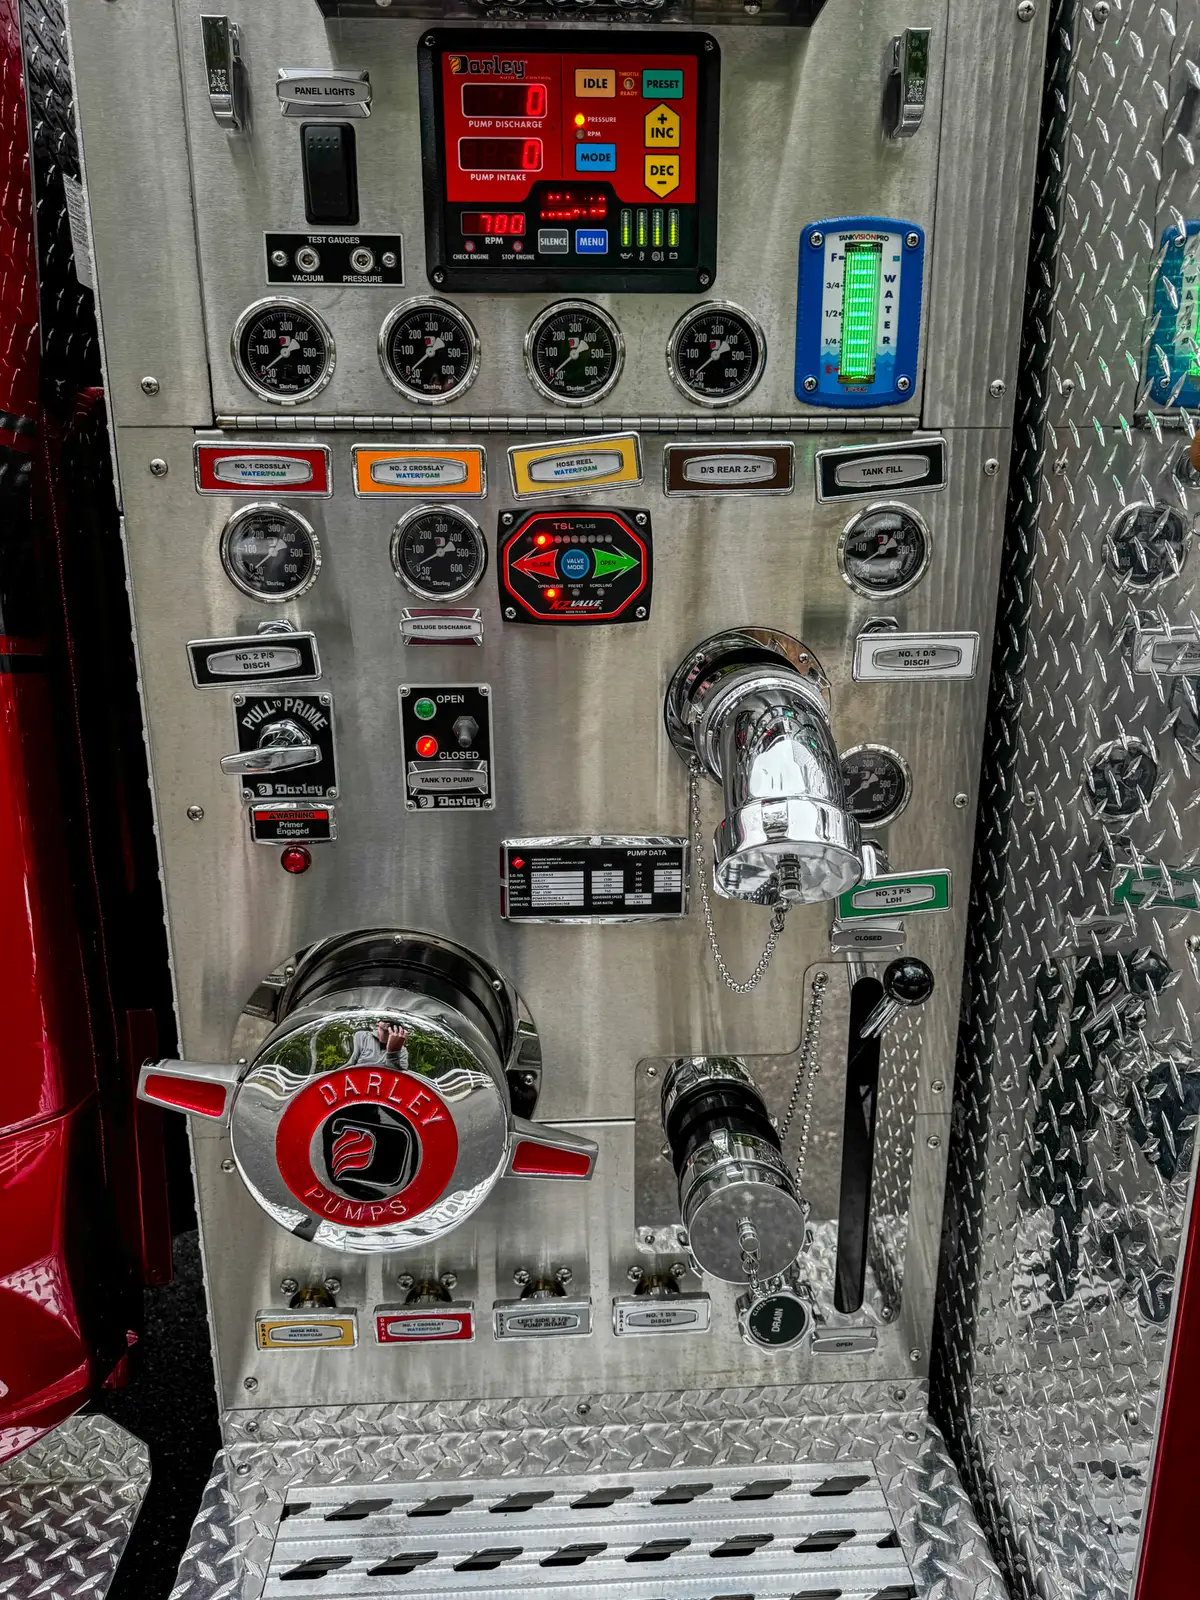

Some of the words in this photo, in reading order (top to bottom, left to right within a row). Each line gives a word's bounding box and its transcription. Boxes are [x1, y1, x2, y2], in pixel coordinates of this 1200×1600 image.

[448, 54, 525, 80] Darley
[583, 78, 608, 89] IDLE
[646, 80, 679, 89] PRESET
[294, 87, 323, 95] PANEL
[324, 87, 355, 96] LIGHTS
[526, 85, 544, 116] 0
[468, 120, 493, 128] PUMP
[495, 120, 542, 129] DISCHARGE
[651, 128, 674, 139] INC
[522, 139, 540, 169] 0
[581, 153, 611, 162] MODE
[651, 165, 674, 176] DEC
[481, 214, 524, 234] 700
[307, 236, 326, 244] TEST
[327, 236, 360, 244] GAUGES
[485, 237, 503, 245] RPM
[540, 237, 567, 246] SILENCE
[580, 237, 604, 246] MENU
[831, 253, 838, 261] F
[292, 274, 324, 282] VACUUM
[342, 275, 383, 283] PRESSURE
[825, 310, 838, 318] 1/2
[882, 274, 897, 345] WATER
[279, 321, 293, 331] 300
[425, 321, 438, 332] 300
[569, 323, 582, 333] 300
[711, 325, 724, 335] 300
[262, 329, 276, 339] 200
[295, 331, 308, 341] 400
[408, 329, 421, 339] 200
[440, 331, 453, 341] 400
[552, 331, 565, 340] 200
[583, 332, 597, 342] 400
[694, 333, 707, 343] 200
[725, 334, 738, 344] 400
[255, 345, 269, 354] 100
[303, 348, 317, 358] 500
[401, 345, 414, 355] 100
[447, 348, 460, 358] 500
[545, 347, 558, 357] 100
[591, 348, 604, 359] 500
[686, 348, 699, 358] 100
[731, 351, 744, 361] 500
[297, 364, 311, 374] 600
[441, 365, 455, 375] 600
[584, 366, 598, 376] 600
[724, 368, 737, 378] 600
[825, 365, 832, 374] E
[554, 465, 598, 476] WATER/FOAM
[700, 466, 716, 474] D/S
[717, 465, 742, 474] REAR
[743, 464, 761, 473] 2.5"
[861, 466, 884, 476] TANK
[885, 465, 903, 474] FILL
[435, 523, 448, 533] 300
[552, 522, 575, 530] TSL
[252, 530, 264, 539] 200
[282, 533, 295, 542] 400
[419, 530, 432, 540] 200
[449, 533, 462, 542] 400
[244, 544, 257, 554] 100
[412, 544, 424, 554] 100
[855, 542, 867, 551] 100
[290, 548, 303, 557] 500
[456, 548, 469, 557] 500
[284, 564, 297, 573] 600
[450, 563, 463, 573] 600
[235, 653, 251, 662] NO.
[260, 651, 275, 660] P/S
[243, 661, 270, 670] DISCH
[436, 695, 465, 704] OPEN
[241, 700, 276, 731] PULL
[272, 700, 282, 708] TO
[283, 697, 329, 732] PRIME
[439, 751, 479, 760] CLOSED
[275, 784, 323, 796] Darley
[438, 796, 481, 807] Darley
[276, 828, 310, 836] Engaged
[318, 1072, 447, 1126] DARLEY
[303, 1183, 408, 1222] PUMPS
[752, 1301, 767, 1317] CLOSE
[771, 1308, 784, 1333] DRAIN
